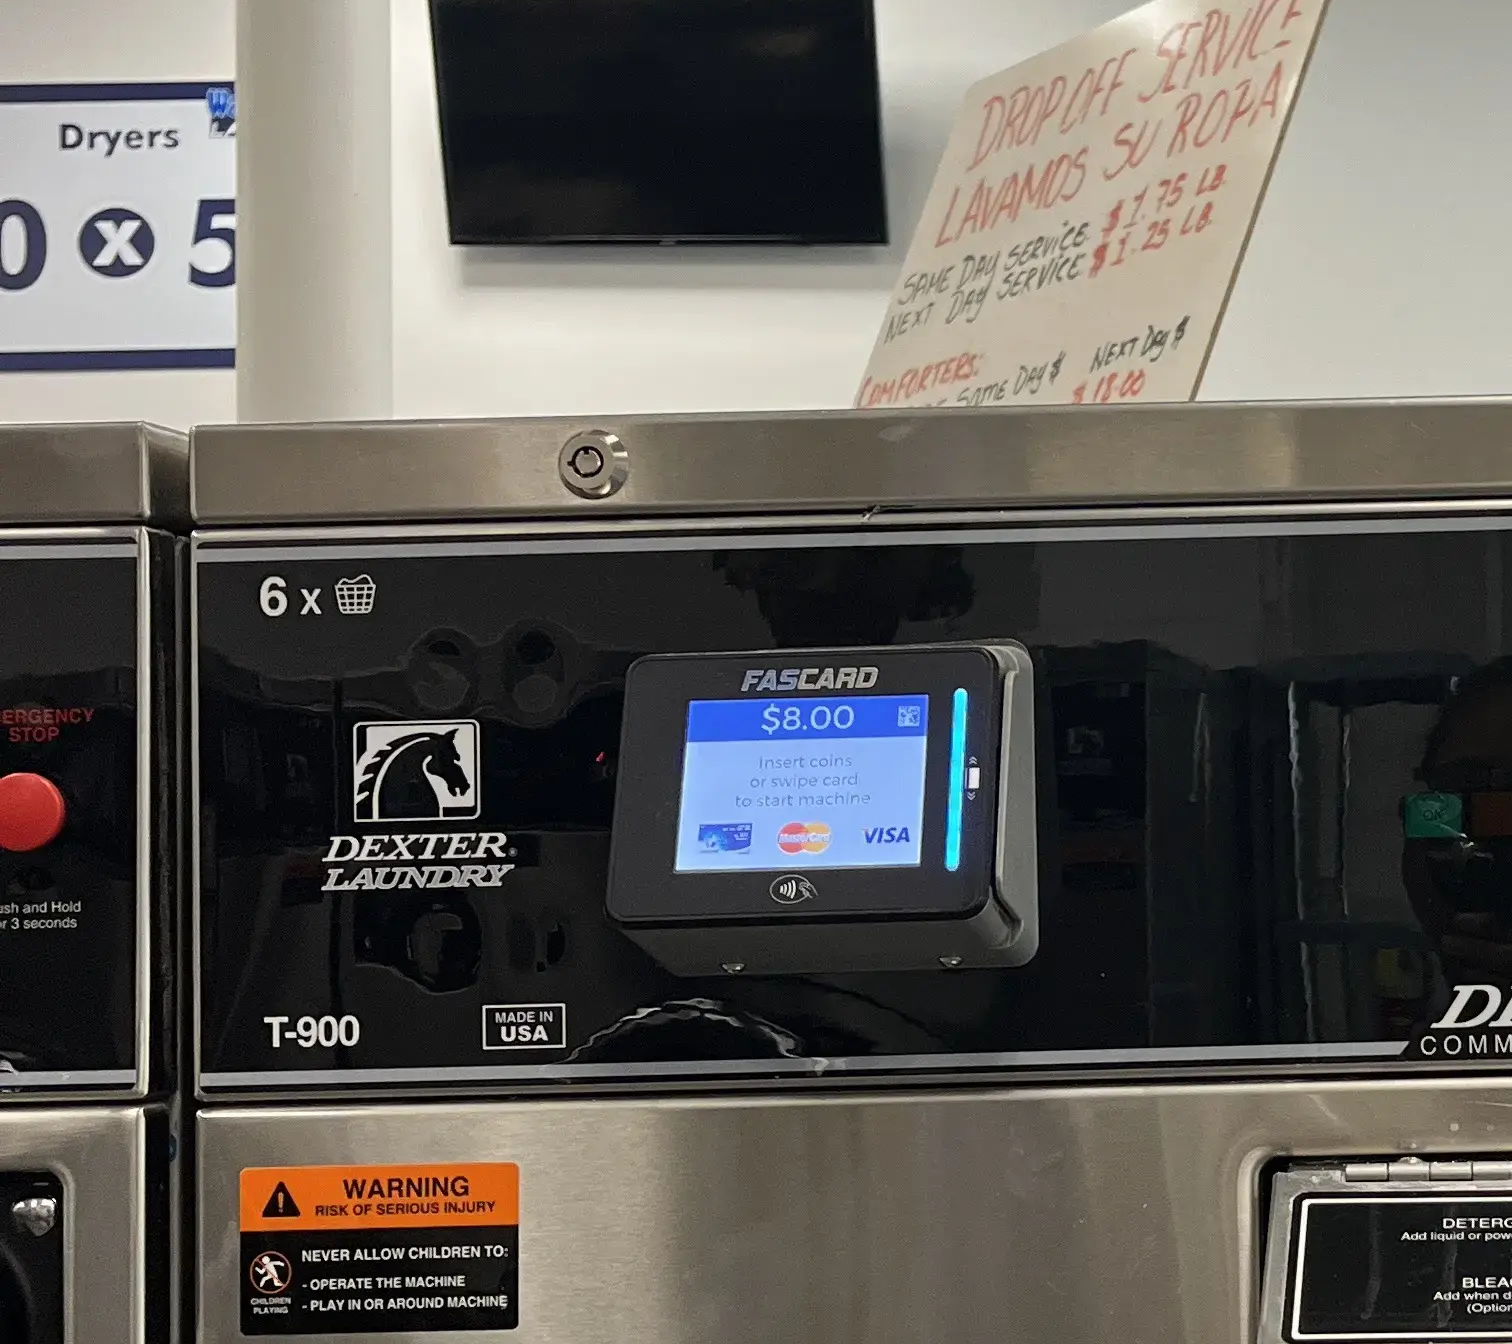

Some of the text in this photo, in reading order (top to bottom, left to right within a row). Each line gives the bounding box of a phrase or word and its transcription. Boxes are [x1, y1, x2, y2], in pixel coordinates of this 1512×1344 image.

[59, 123, 179, 158] Dryers
[935, 61, 1282, 248] LAVAMOS SU ROPA
[884, 303, 934, 344] NEXT
[1090, 336, 1140, 374] NEXT
[260, 576, 322, 617] 6 x
[741, 667, 878, 691] FASCARD
[761, 703, 855, 735] $8.00
[8, 727, 59, 742] STOP
[758, 754, 852, 770] Insert coins
[749, 773, 858, 791] or swipe card
[735, 791, 871, 807] to start machine
[862, 827, 910, 845] VISA
[322, 832, 507, 862] DEXTER
[321, 864, 515, 891] LAUNDRY
[22, 901, 48, 914] and
[51, 901, 82, 913] Hold
[11, 917, 20, 930] 3
[23, 917, 77, 929] seconds
[495, 1011, 553, 1024] MADE IN
[264, 1015, 360, 1048] T-900
[500, 1025, 548, 1043] USA
[343, 1176, 469, 1199] WARNING
[315, 1201, 495, 1217] RISK OF SERIOUS INJURY
[1401, 1231, 1427, 1241] Add
[1431, 1231, 1464, 1242] liquid
[1468, 1232, 1480, 1240] or
[302, 1245, 508, 1262] NEVER ALLOW CHILDREN TO:
[310, 1276, 466, 1290] OPERATE THE MACHINE
[310, 1295, 508, 1312] PLAY IN OR AROUND MACHINE
[1433, 1291, 1460, 1301] Add
[1464, 1291, 1499, 1300] when
